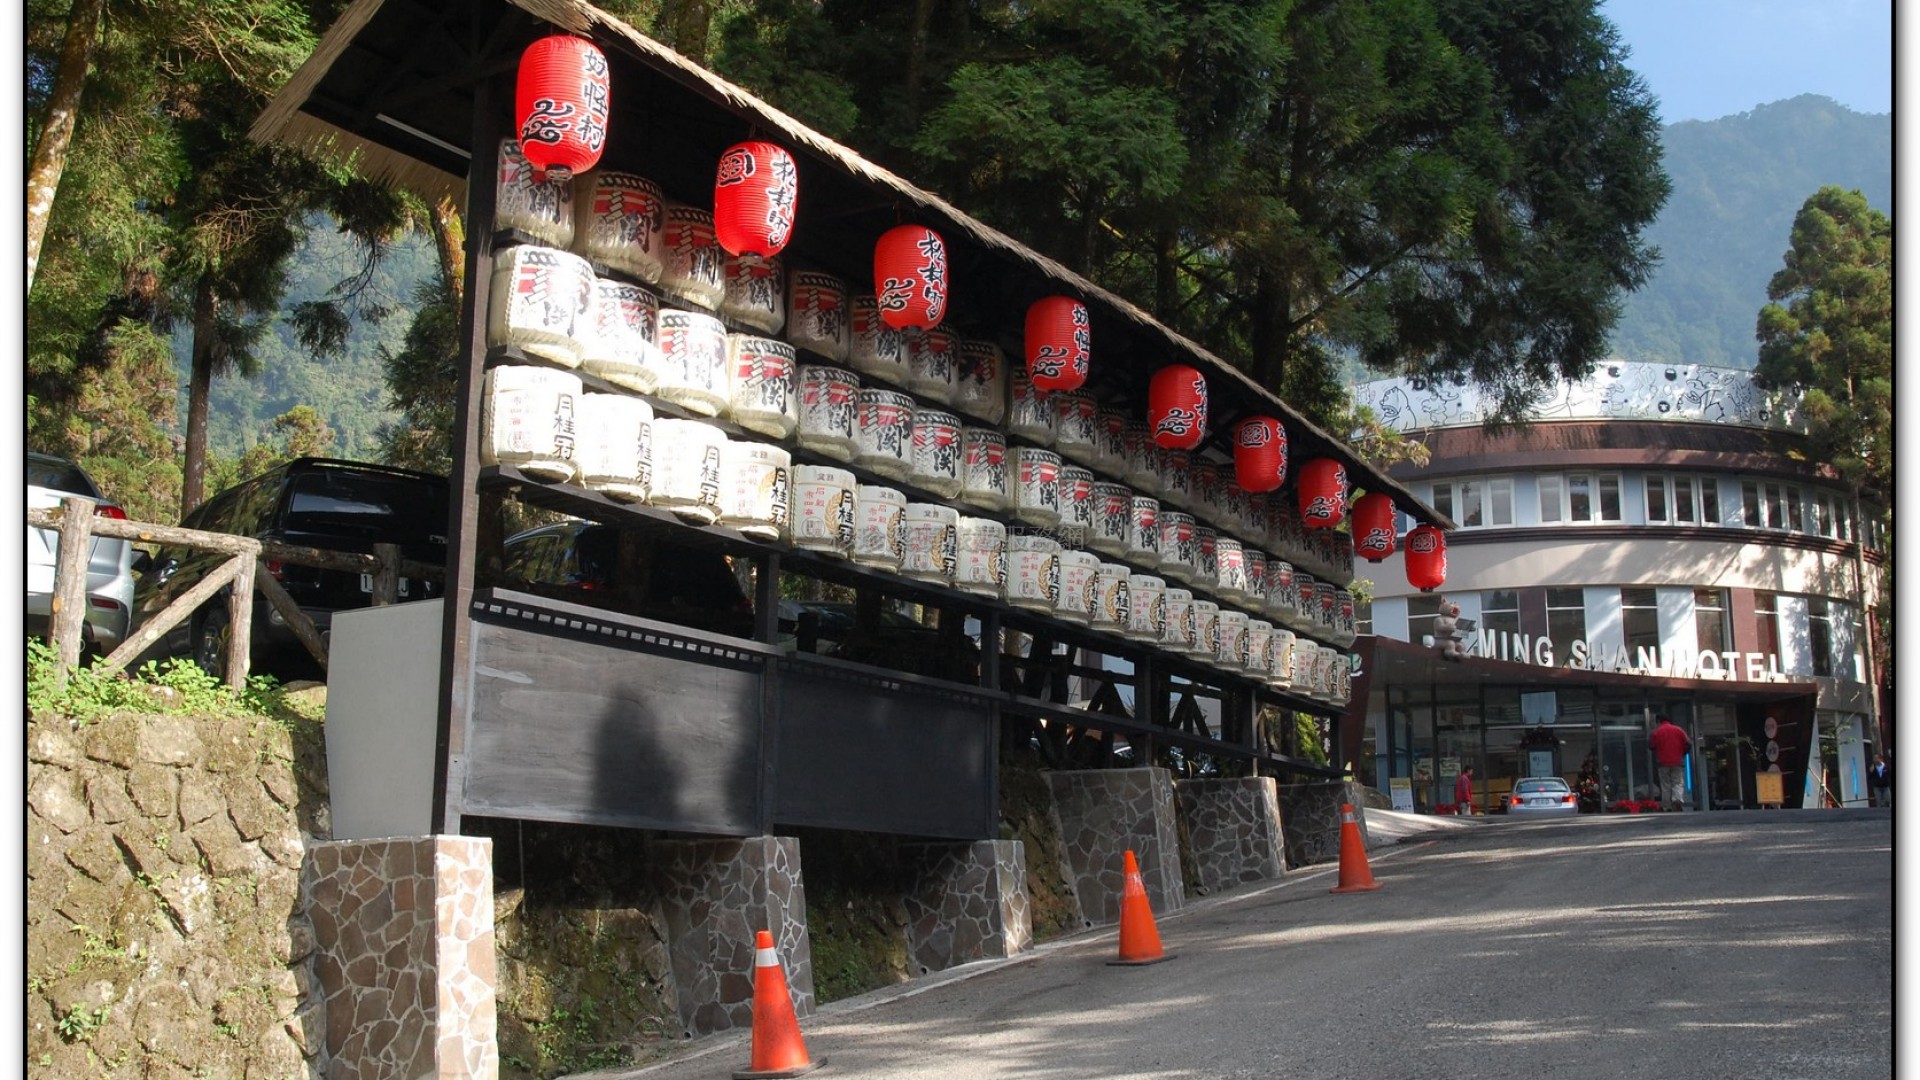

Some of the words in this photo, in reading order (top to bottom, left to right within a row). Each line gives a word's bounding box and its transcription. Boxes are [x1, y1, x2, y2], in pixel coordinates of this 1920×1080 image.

[552, 392, 576, 460] 月桂冠
[635, 421, 653, 486] 月桂冠
[699, 444, 720, 505] 月桂冠
[770, 466, 787, 525] 月桂冠
[838, 489, 854, 545] 月桂冠
[942, 524, 957, 577] 月桂冠
[1478, 627, 1554, 667] MING
[1569, 639, 1659, 678] SHAN
